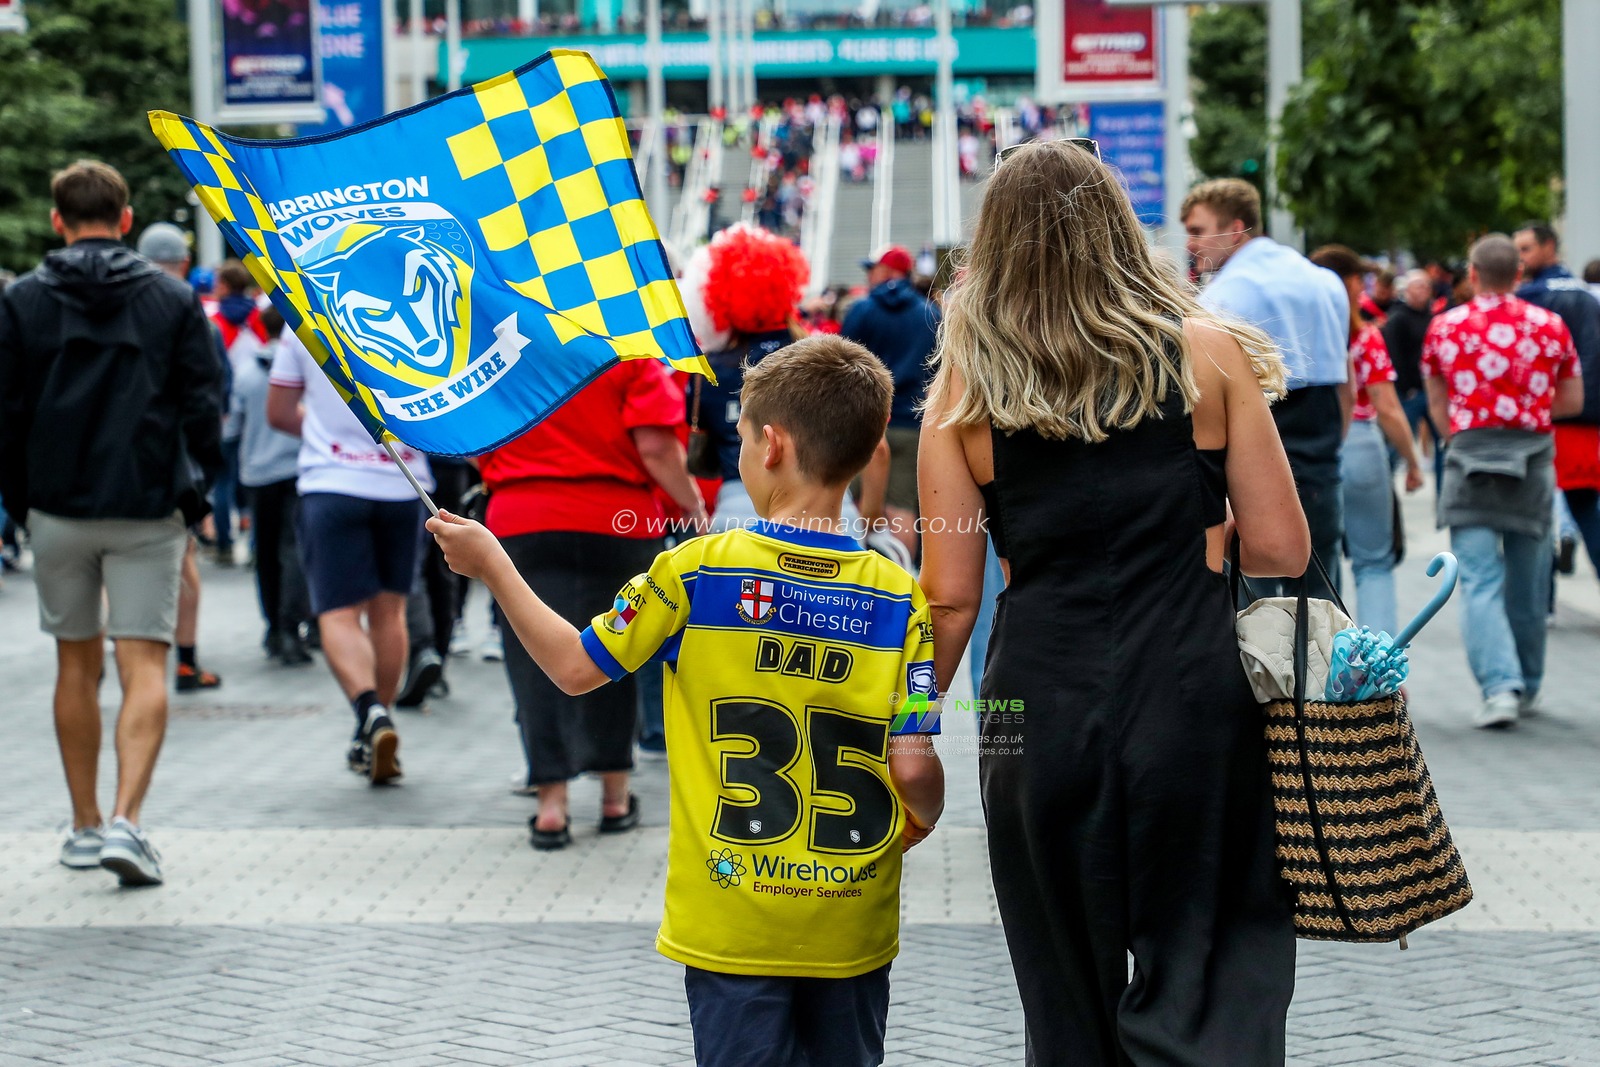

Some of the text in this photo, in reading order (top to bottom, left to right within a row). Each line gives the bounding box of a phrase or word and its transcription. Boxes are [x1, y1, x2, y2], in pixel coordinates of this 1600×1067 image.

[280, 206, 406, 248] WOLVES
[401, 351, 508, 417] THE WIRE
[783, 562, 834, 575] FABRICATIONS
[784, 556, 835, 569] WARRINGTON
[621, 581, 647, 610] TCAT
[642, 574, 680, 613] oodBank
[781, 585, 875, 612] University of
[779, 602, 873, 636] Chester
[755, 635, 855, 684] DAD
[709, 695, 899, 856] 35
[752, 853, 877, 883] Wirehouse
[753, 881, 862, 898] Employer Services
